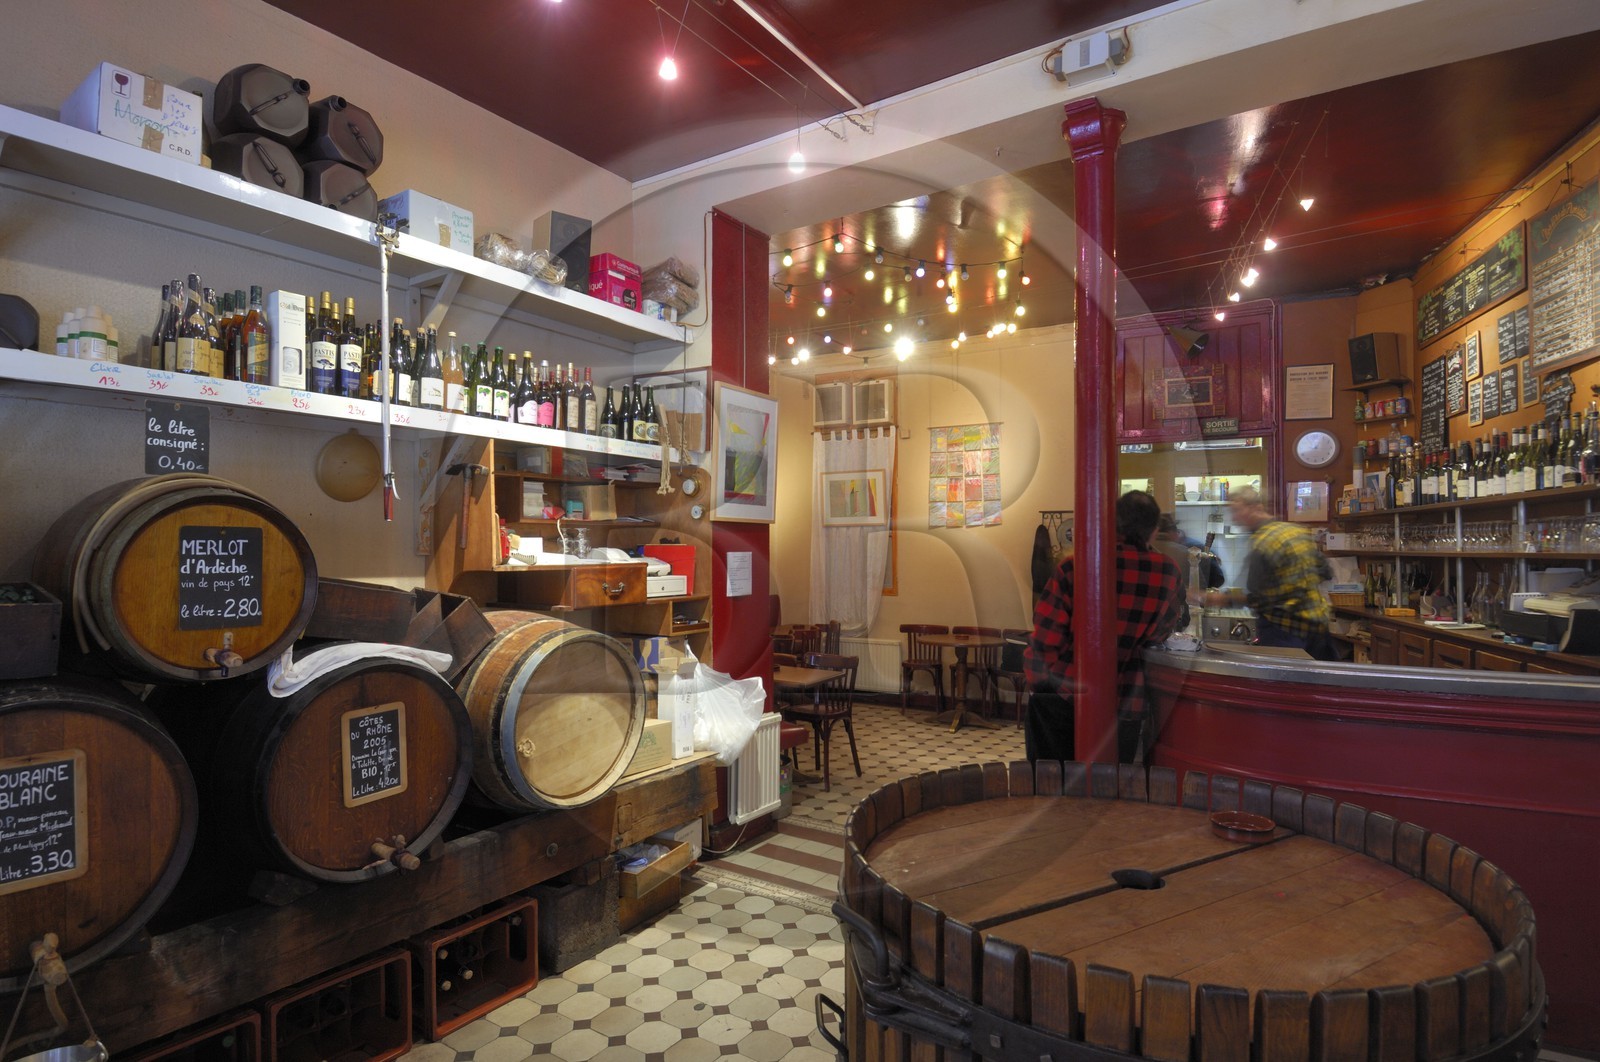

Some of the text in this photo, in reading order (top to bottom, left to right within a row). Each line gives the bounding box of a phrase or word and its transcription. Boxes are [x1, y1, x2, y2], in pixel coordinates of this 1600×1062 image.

[168, 143, 193, 157] C.R.D.
[314, 347, 335, 357] PASTIS
[343, 350, 361, 359] PASTI
[148, 417, 196, 437] le litre
[1206, 420, 1235, 429] SORTIE
[146, 437, 198, 453] consigné
[182, 539, 249, 556] MERLOT
[180, 558, 248, 575] d'Ardèche
[181, 580, 195, 588] vin
[198, 577, 209, 588] de
[213, 580, 235, 592] pays
[181, 604, 190, 618] le
[193, 604, 215, 617] litre
[359, 715, 384, 728] CÔTES
[351, 723, 393, 740] DU RHÔNE
[363, 735, 387, 750] 2005
[0, 764, 69, 789] OURAINE
[361, 765, 378, 779] BIO
[0, 783, 57, 810] BLANC
